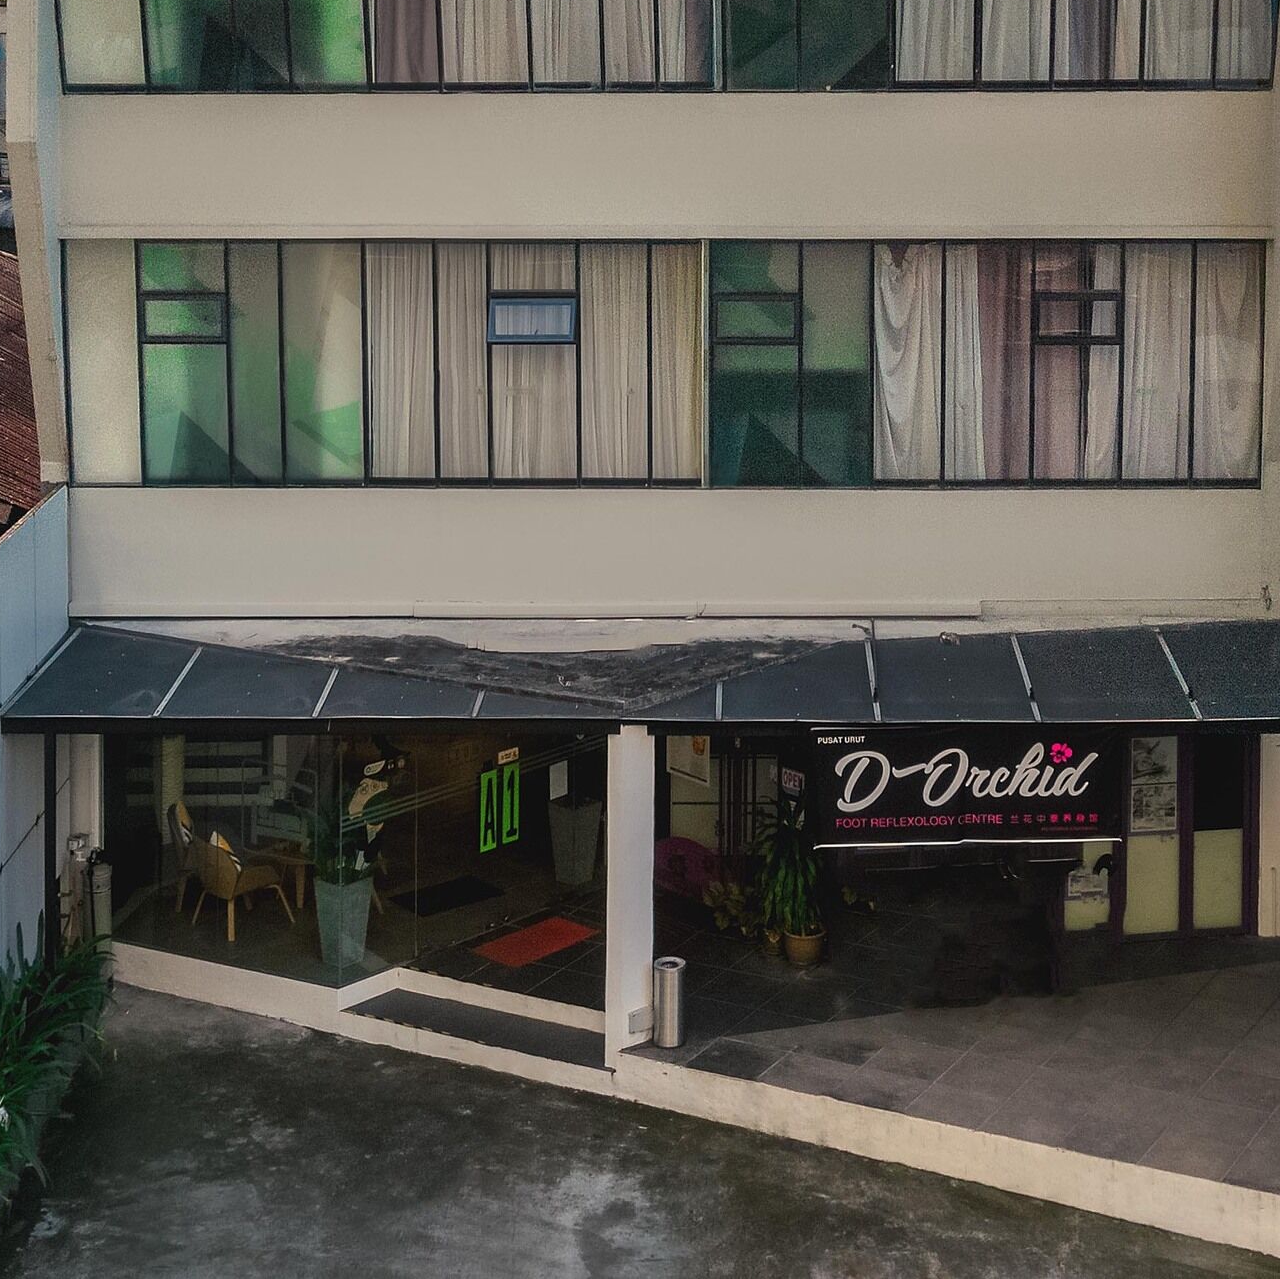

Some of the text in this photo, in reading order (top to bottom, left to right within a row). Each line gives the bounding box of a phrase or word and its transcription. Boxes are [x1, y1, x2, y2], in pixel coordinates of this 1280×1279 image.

[817, 735, 866, 745] PUSAT URUT
[833, 741, 1100, 814] D-Orchid
[836, 813, 1003, 830] FOOT REFLEXOLOGY CENTRE
